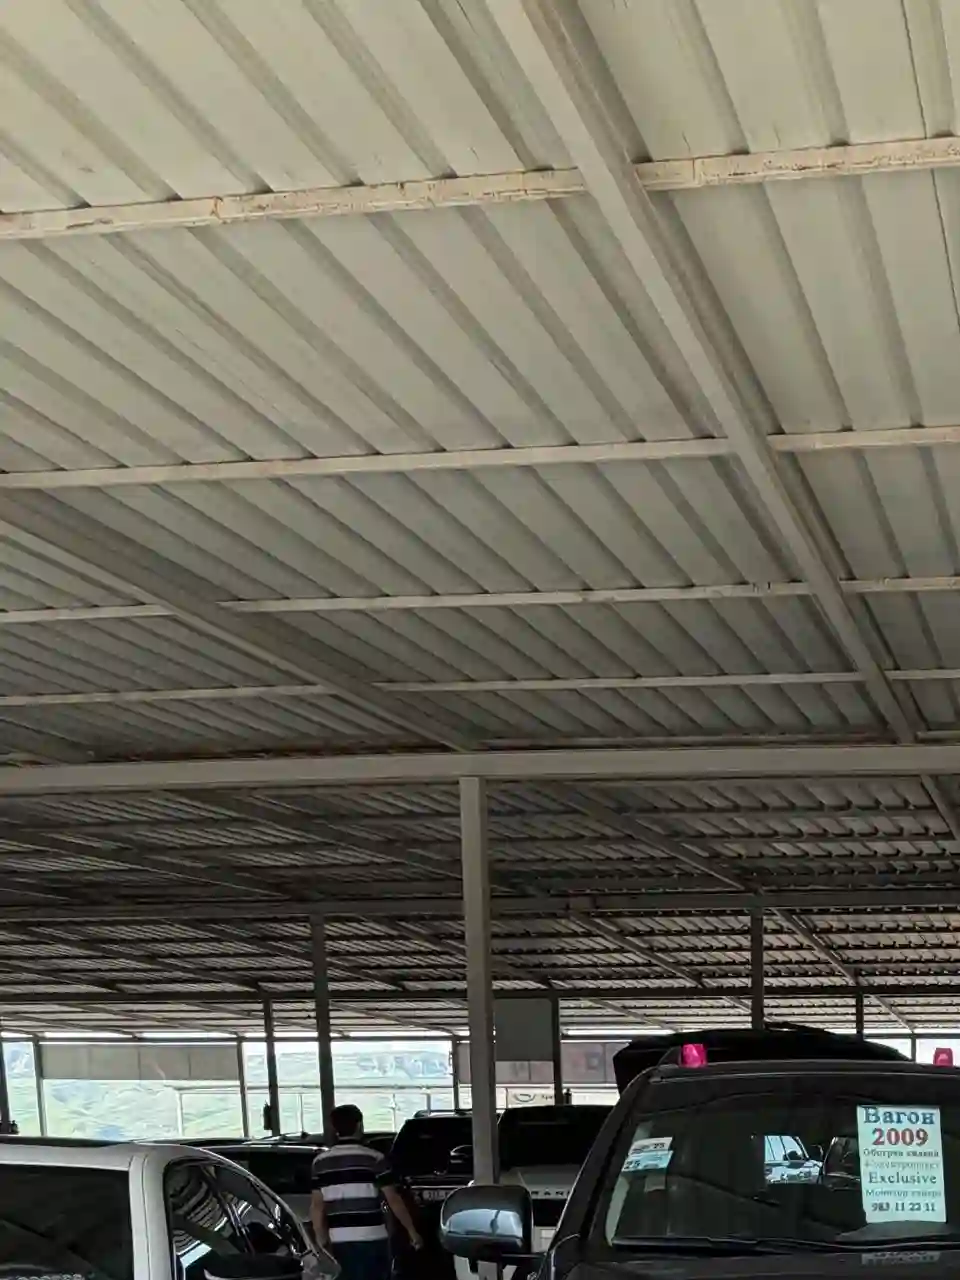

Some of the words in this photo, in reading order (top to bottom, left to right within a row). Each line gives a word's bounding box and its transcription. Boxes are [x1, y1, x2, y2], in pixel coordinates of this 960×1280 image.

[863, 1107, 935, 1125] Вагон
[871, 1128, 929, 1147] 2009
[868, 1172, 937, 1184] Exclusive
